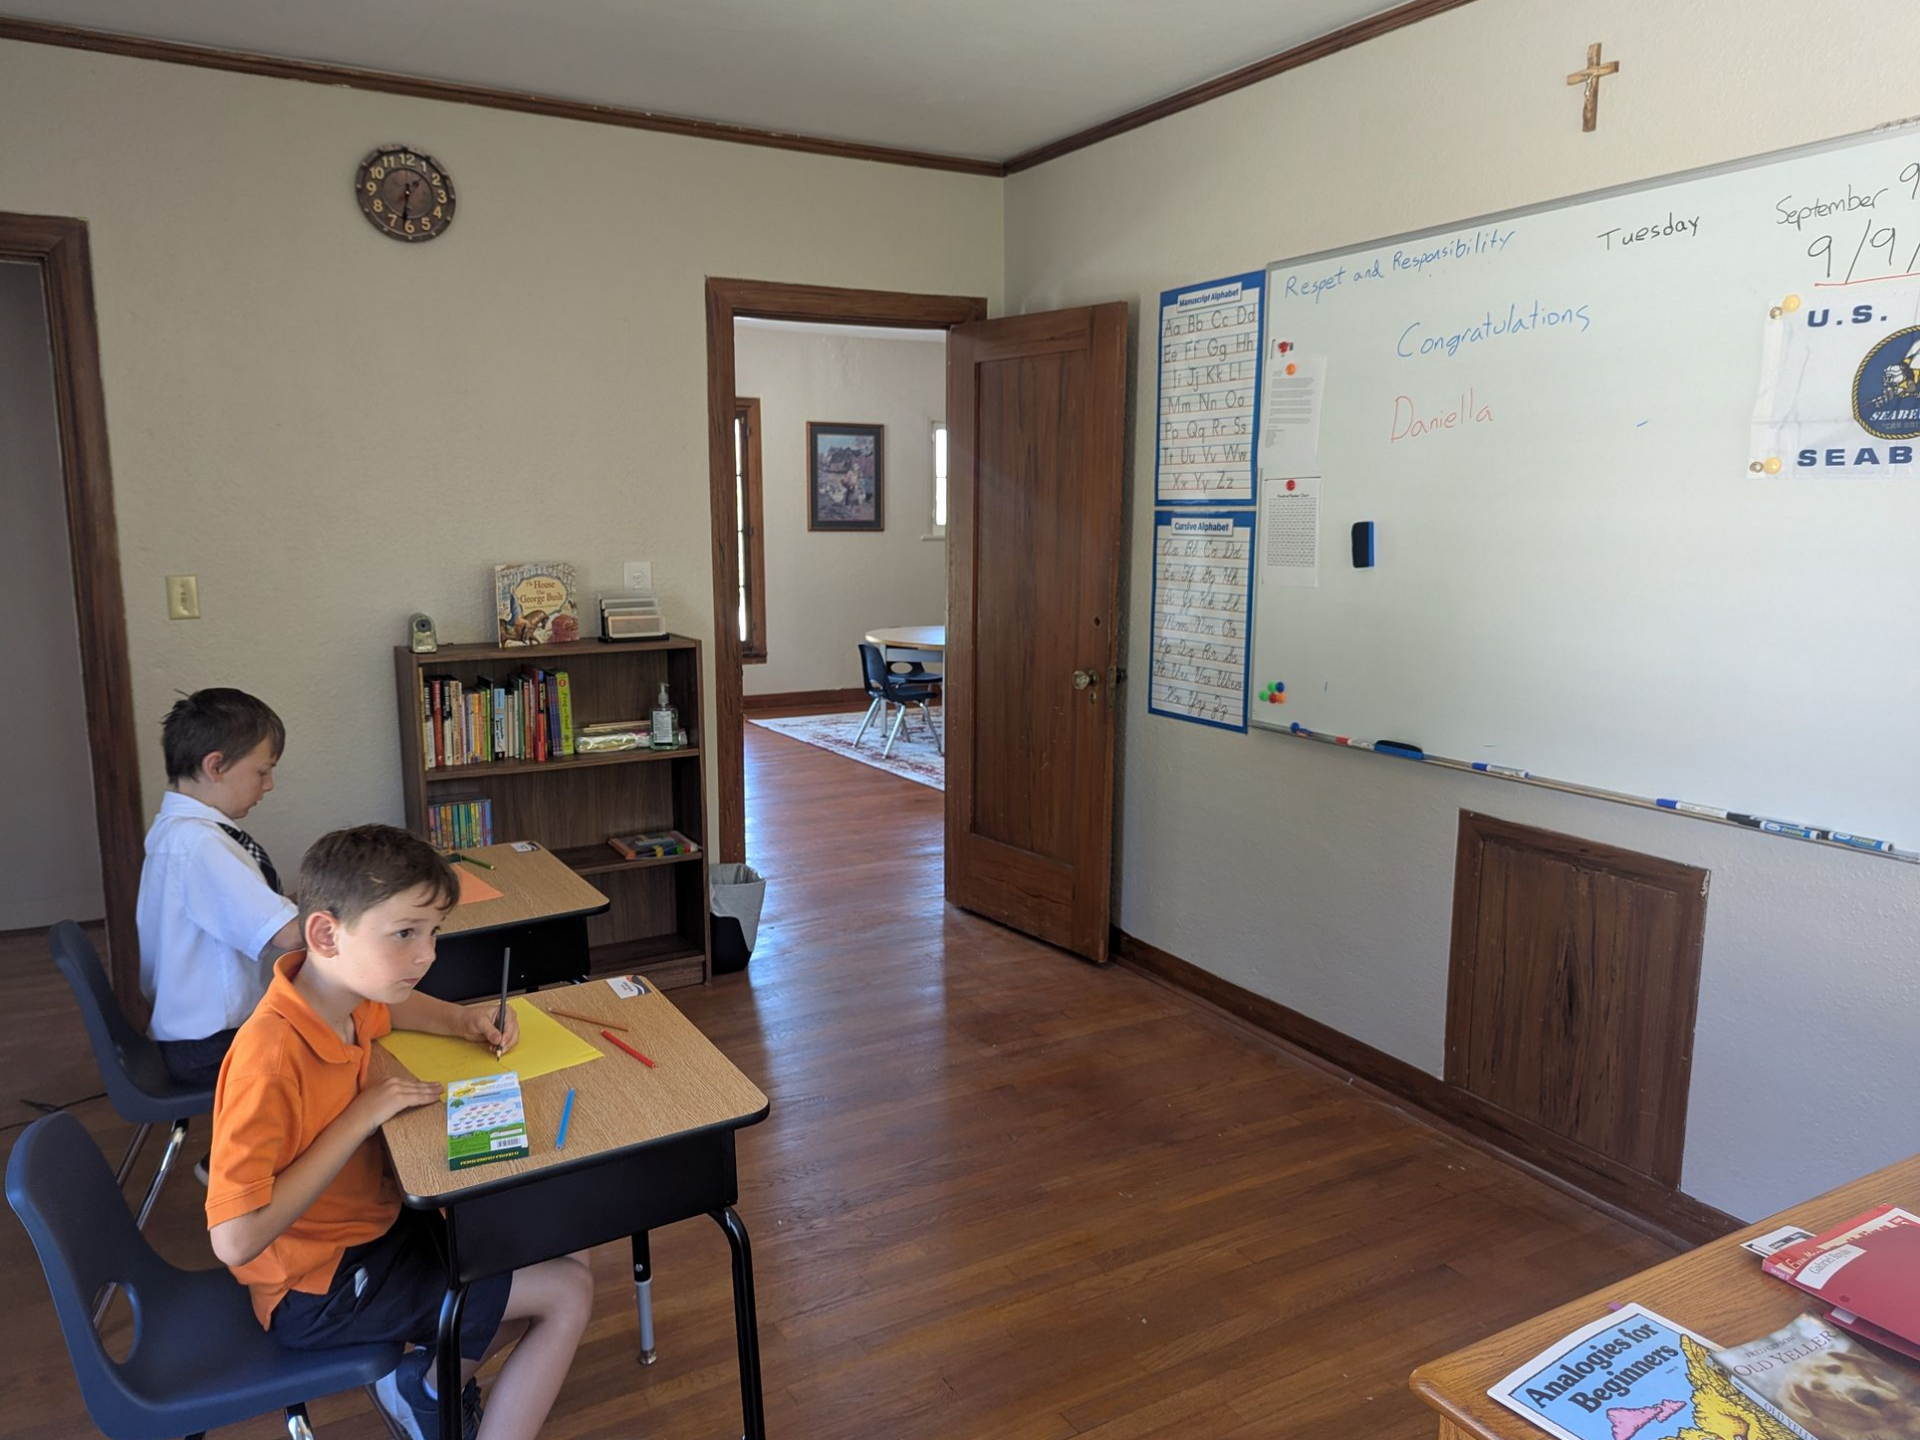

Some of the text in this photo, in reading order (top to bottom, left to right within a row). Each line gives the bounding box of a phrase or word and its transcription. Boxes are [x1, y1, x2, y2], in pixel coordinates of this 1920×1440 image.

[382, 155, 395, 168] 11
[399, 153, 416, 167] 12
[420, 161, 427, 173] 1
[369, 166, 385, 180] 10
[431, 173, 441, 186] 2
[366, 181, 377, 196] 9
[437, 189, 447, 204] 3
[372, 199, 383, 213] 8
[433, 205, 442, 219] 4
[1775, 184, 1889, 231] September
[387, 213, 398, 227] 7
[404, 220, 415, 234] 6
[421, 217, 431, 231] 5
[1597, 212, 1700, 250] Tuesday
[1285, 228, 1515, 304] Respet and Responsibility
[1179, 288, 1239, 307] Manuscript Alphabet
[1164, 303, 1255, 337] Aa Bb Cc Dd
[1397, 300, 1590, 358] Congratulations
[1164, 333, 1254, 363] Ee Ff Gg Hh
[1187, 367, 1200, 392] Jj
[1206, 364, 1222, 384] Kk
[1168, 389, 1244, 413] Mm Nn Oo
[1391, 388, 1493, 444] Daniella
[1870, 408, 1920, 421] SEABE
[1165, 416, 1246, 445] Pp Qq Rr Ss
[1162, 444, 1247, 465] Tt Uu Vv Ww
[1172, 470, 1234, 493] Xx Yy Zz
[1174, 521, 1229, 533] Cursive Alphabet
[533, 580, 555, 589] House
[520, 592, 563, 605] George Built
[1808, 1253, 1837, 1275] Gabriel
[1733, 1330, 1838, 1377] OLD YELLER
[1525, 1322, 1659, 1409] Analogies for
[1567, 1343, 1679, 1414] Beginners
[1764, 1402, 1785, 1421] OLD
